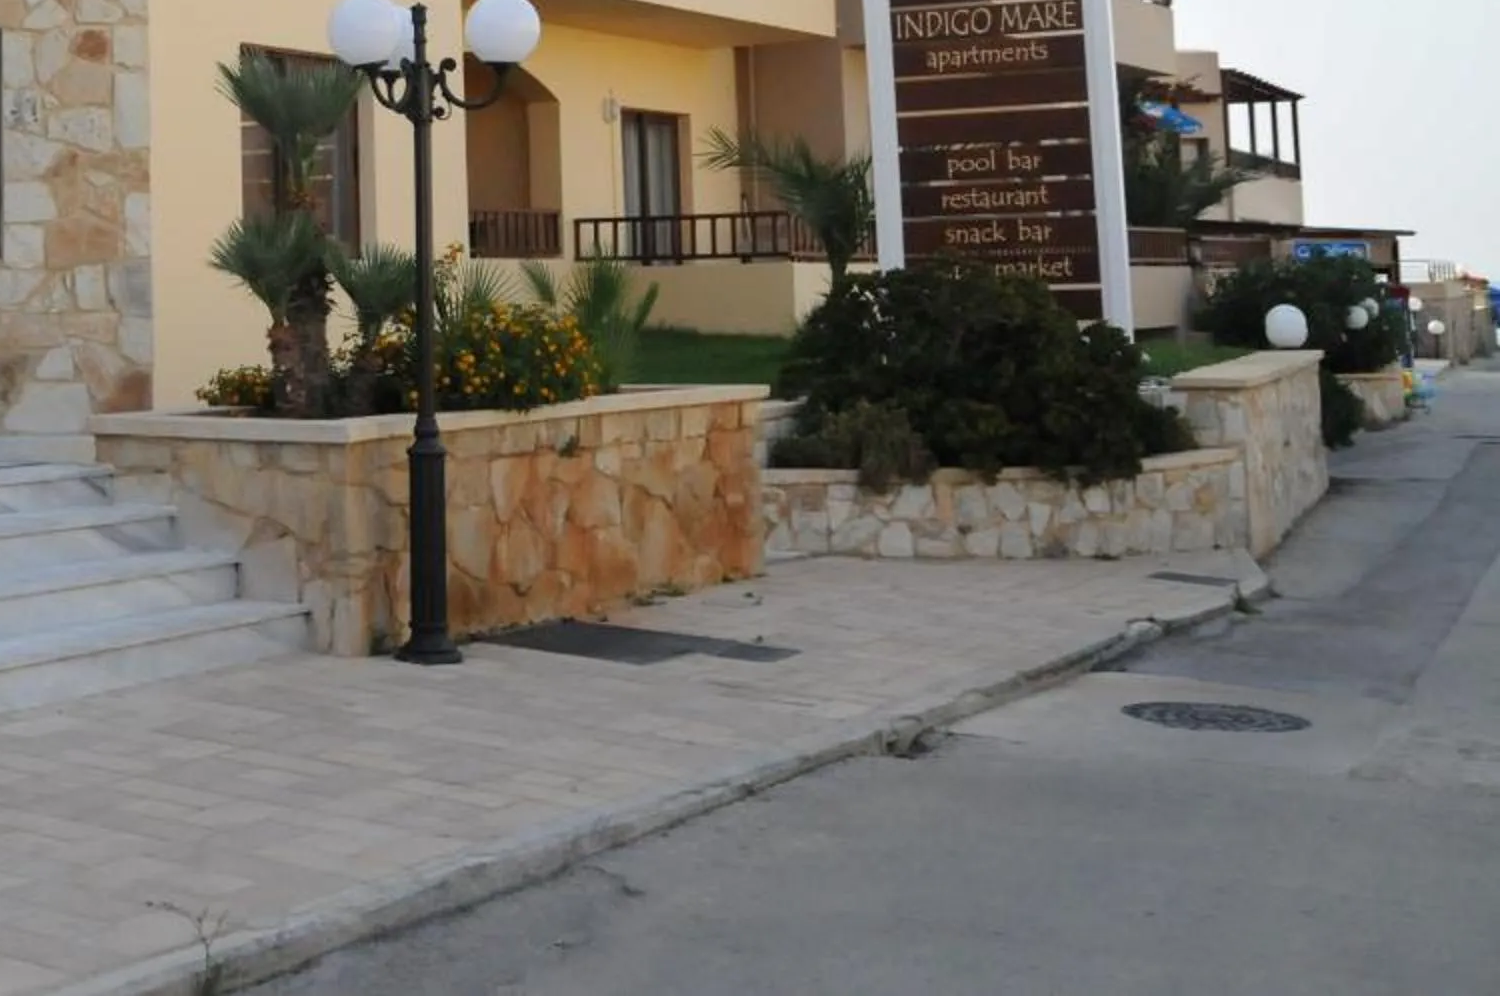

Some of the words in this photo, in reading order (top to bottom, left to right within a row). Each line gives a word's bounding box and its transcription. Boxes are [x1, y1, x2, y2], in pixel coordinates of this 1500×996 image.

[896, 8, 992, 39] INDIGO
[1000, 1, 1077, 31] MARE
[926, 41, 1048, 72] apartments
[947, 149, 996, 179] pool
[1008, 148, 1042, 170] bar
[941, 184, 1049, 209] restaurant
[944, 220, 1006, 244] snack
[1018, 217, 1052, 243] bar
